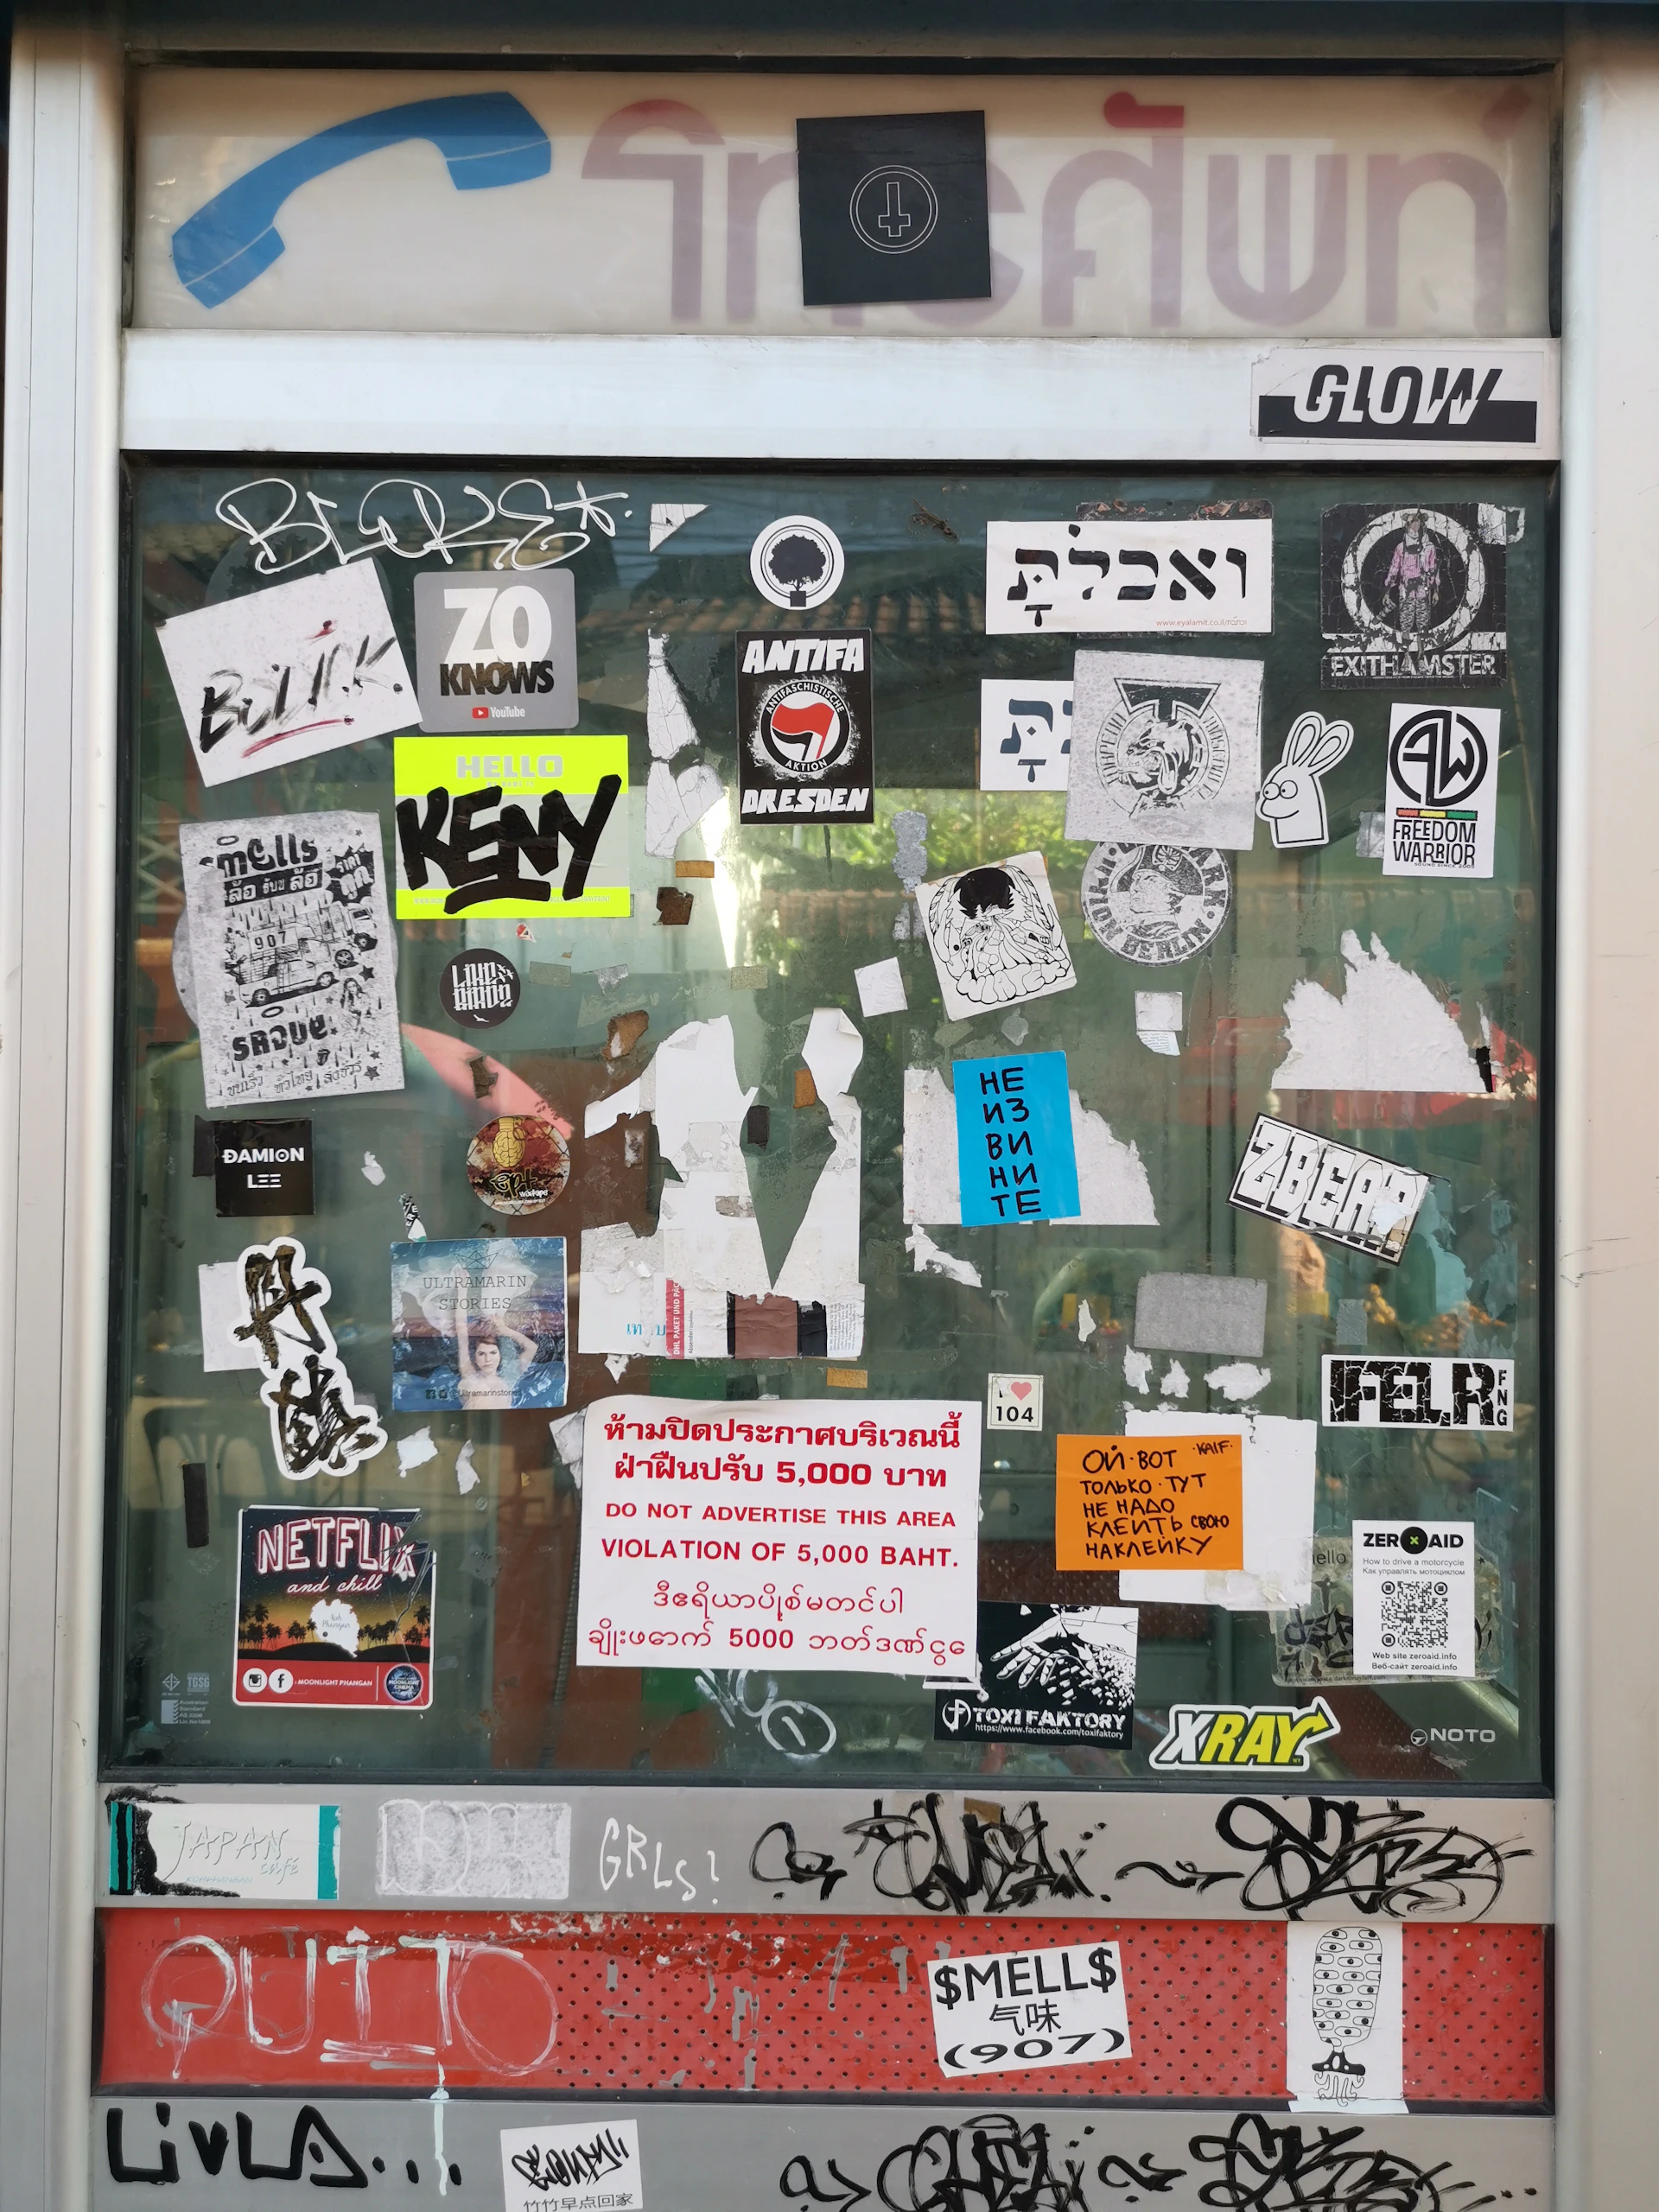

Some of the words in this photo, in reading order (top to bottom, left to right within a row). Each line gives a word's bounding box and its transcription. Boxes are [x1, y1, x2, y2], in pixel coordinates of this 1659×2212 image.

[1294, 363, 1503, 426] GLOW
[444, 585, 552, 664] ZO
[741, 638, 865, 675] ANTIFA
[1331, 654, 1497, 677] EXITHAMSTER
[439, 660, 555, 696] KNOWS
[765, 681, 845, 715] ANTIFASCHISTISCHE
[490, 706, 525, 718] YouTube
[456, 754, 563, 779] HELLO
[785, 758, 829, 772] AKTION
[741, 787, 870, 815] DRESDEN
[396, 774, 622, 901] KENY
[1393, 819, 1477, 843] FREEDOM
[1393, 841, 1476, 866] WARRIOR
[254, 931, 287, 950] 907
[1120, 917, 1212, 961] BERLIN
[980, 1067, 1024, 1095] НЕ
[982, 1098, 1030, 1124] ИЗ
[985, 1131, 1033, 1160] ВИ
[247, 1174, 282, 1189] LEE
[989, 1163, 1038, 1189] НИ
[991, 1189, 1042, 1217] ТЕ
[423, 1275, 527, 1289] ULTRAMARIN
[439, 1298, 512, 1310] STORIES
[996, 1406, 1034, 1423] 104
[603, 1411, 961, 1448] ห้ามปิดประกาศบริเวณนี้
[614, 1451, 763, 1484] ฝ่าฝืนปรับ
[777, 1461, 872, 1487] 5,000
[885, 1466, 946, 1487] บาท
[1082, 1445, 1126, 1474] ОЙ
[1137, 1449, 1178, 1470] ВОТ
[1079, 1479, 1153, 1496] ТОЛЬКО
[1165, 1472, 1207, 1494] ТУТ
[606, 1503, 637, 1517] DO
[647, 1503, 692, 1519] NOT
[702, 1505, 827, 1524] ADVERTISE
[836, 1510, 887, 1525] THIS
[897, 1511, 956, 1527] AREA
[1083, 1502, 1109, 1519] НЕ
[1116, 1497, 1175, 1516] НАДО
[1086, 1516, 1183, 1539] КЛЕИТЬ
[1191, 1514, 1230, 1530] СВОЮ
[257, 1516, 416, 1580] NETFLIX
[601, 1538, 741, 1560] VIOLATION
[752, 1542, 785, 1561] OF
[798, 1544, 868, 1566] 5,000
[880, 1547, 959, 1567] BAHT.
[1085, 1535, 1213, 1560] НАКЛЕЙКУ
[1421, 1559, 1465, 1568] motorcycle
[287, 1575, 330, 1593] and
[336, 1573, 383, 1592] chill
[729, 1628, 793, 1649] 5000
[1392, 1651, 1408, 1660] site
[1409, 1652, 1458, 1661] zeroaid.info
[1410, 1662, 1458, 1671] zeroaid.info
[973, 1707, 1022, 1726] TOXI
[1026, 1709, 1126, 1731] FAKTORY
[975, 1723, 1124, 1740] https://www.facebook.com/toxifaktory
[1158, 1703, 1332, 1764] XRAY
[1430, 1728, 1497, 1743] NOTO
[163, 1821, 289, 1881] JAPAN
[934, 1947, 1117, 2011] $MELL$
[988, 1998, 1062, 2037] 气味
[944, 2027, 1125, 2069] (907)
[523, 2191, 634, 2212] 竹竹早点回家
